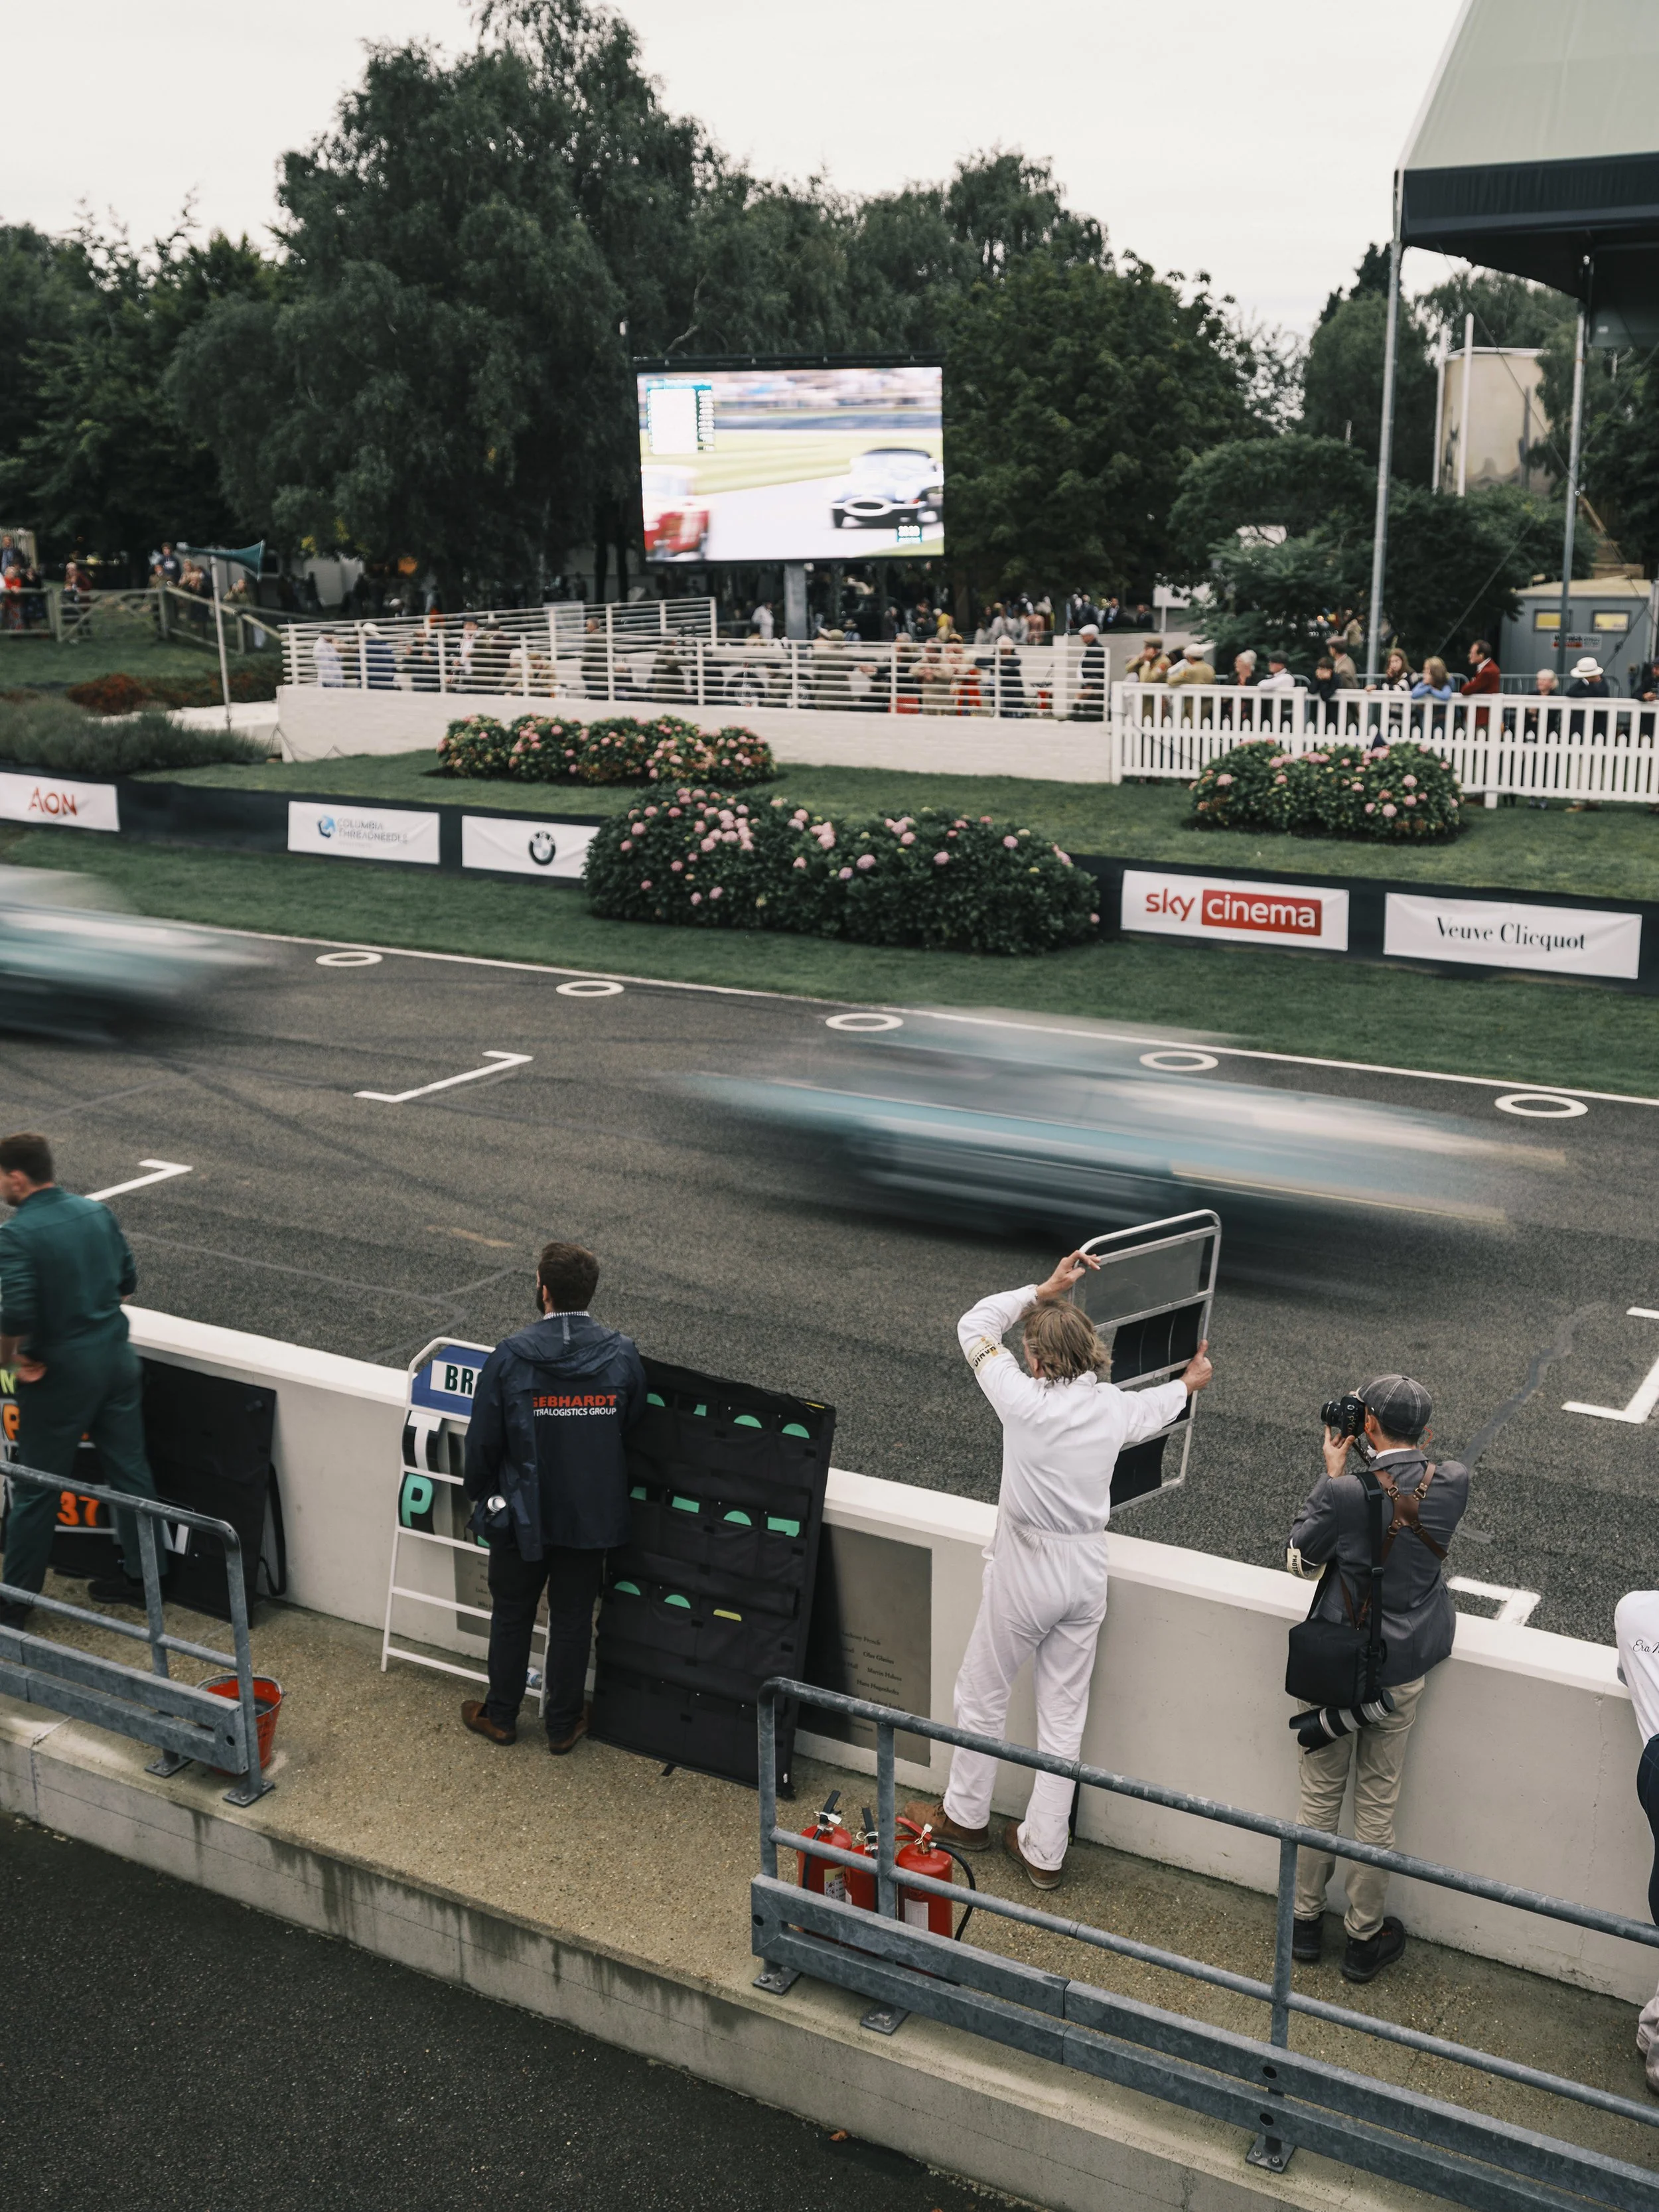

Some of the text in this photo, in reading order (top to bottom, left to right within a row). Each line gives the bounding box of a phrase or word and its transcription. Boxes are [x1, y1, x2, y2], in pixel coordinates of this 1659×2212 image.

[29, 786, 78, 817] AON
[1145, 887, 1317, 930] sky cinema
[1437, 917, 1587, 953] Veuve Clicquot
[589, 1407, 616, 1416] GROUP
[401, 1473, 433, 1528] P
[1632, 1639, 1651, 1653] Era
